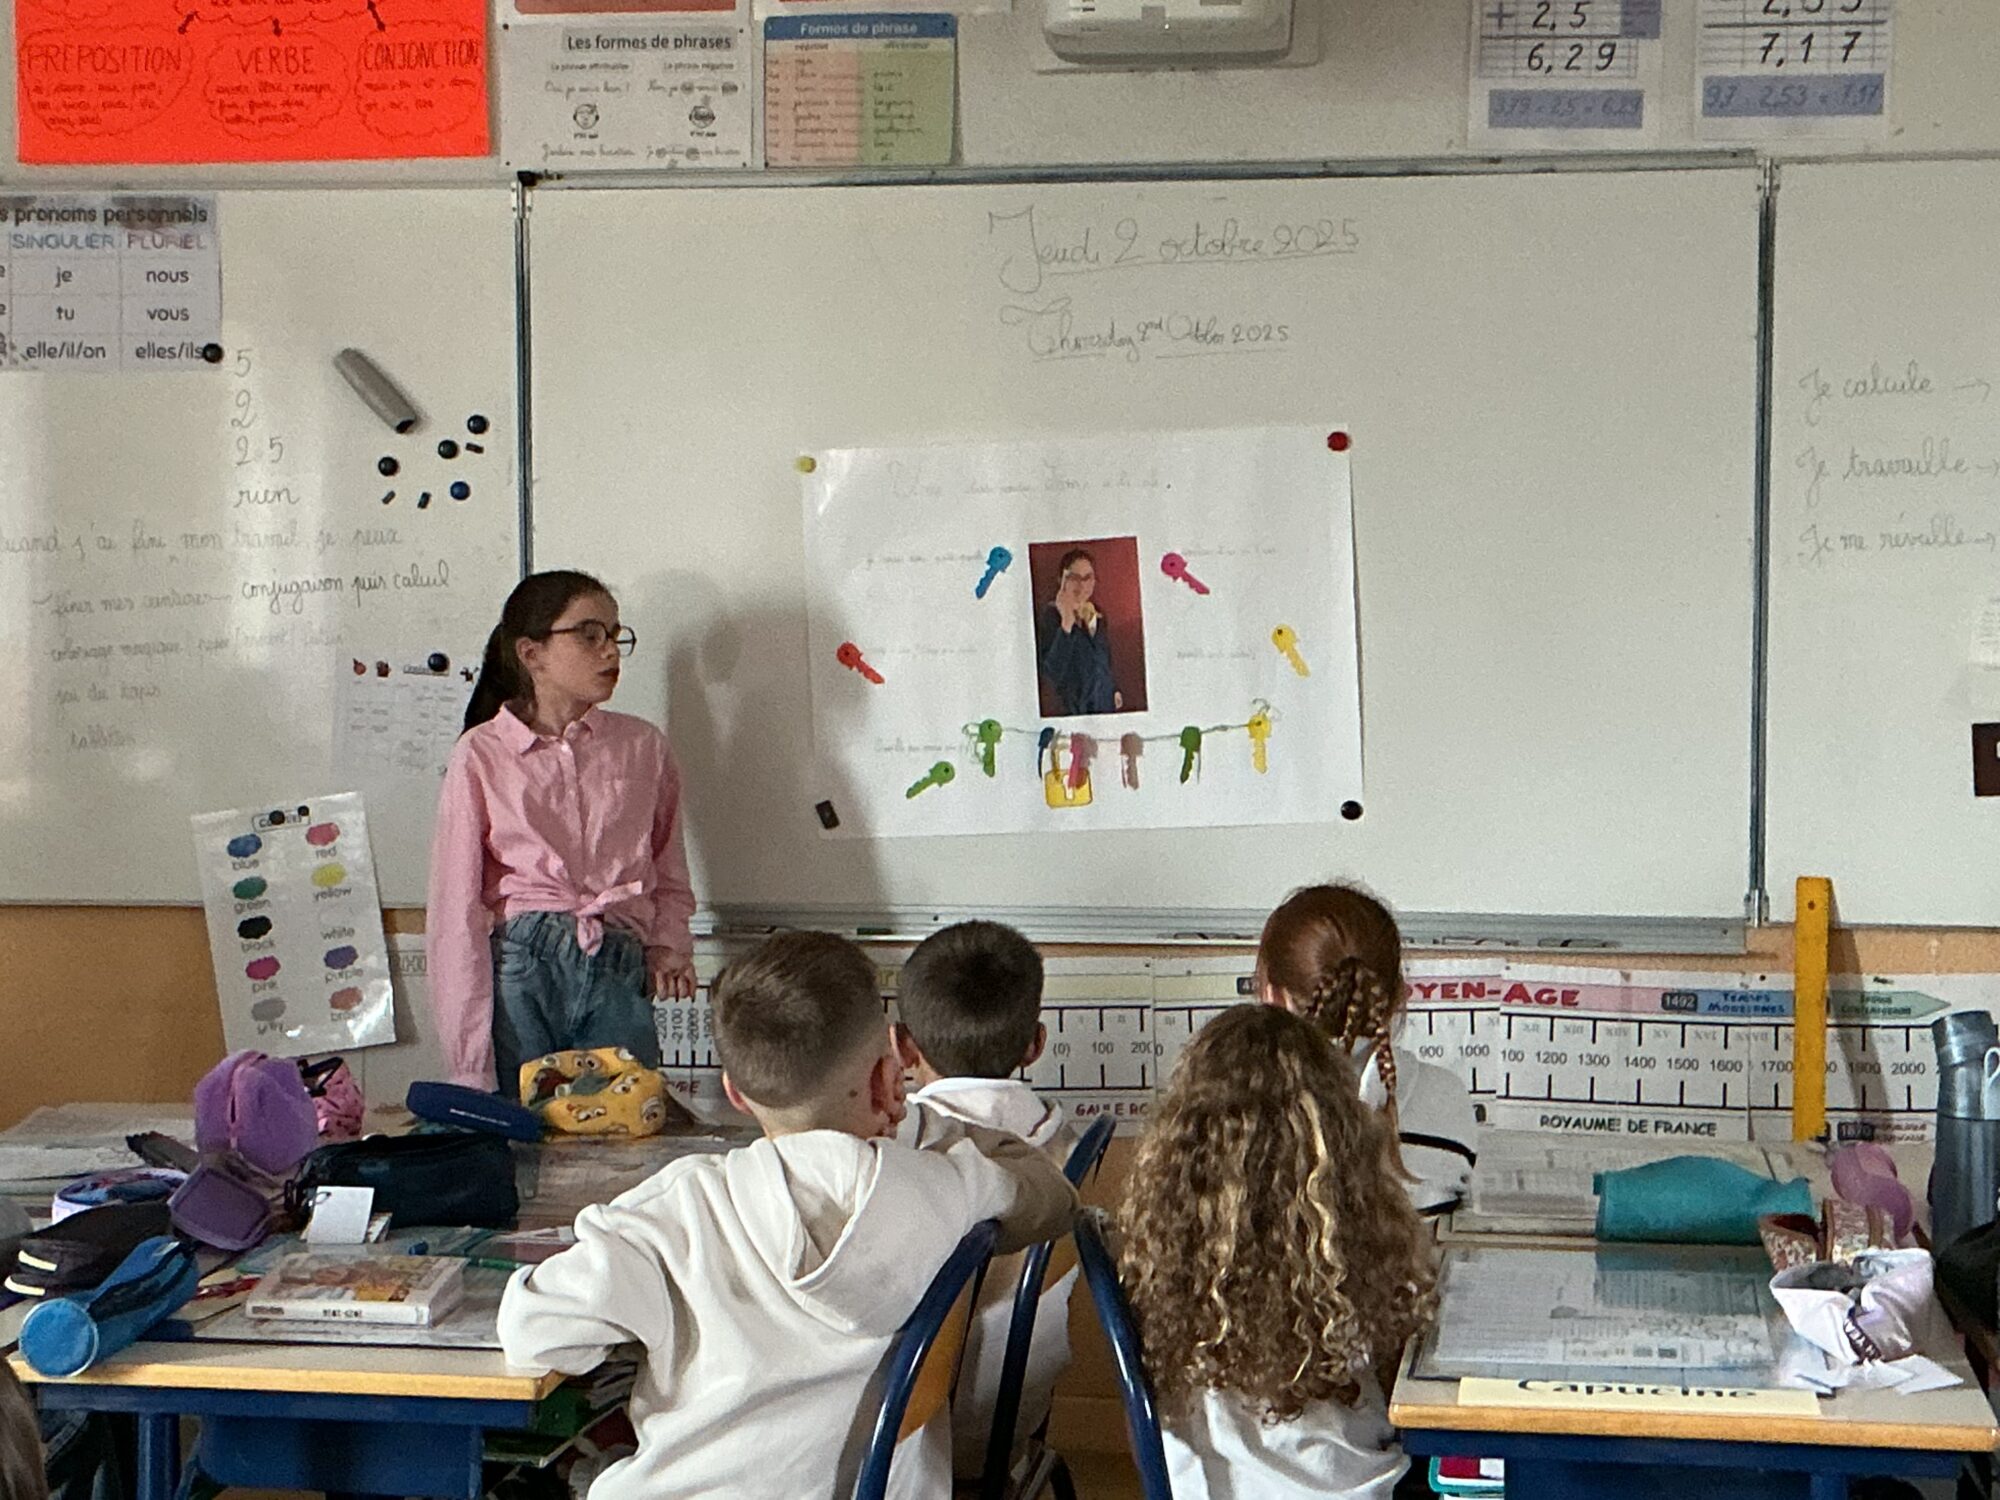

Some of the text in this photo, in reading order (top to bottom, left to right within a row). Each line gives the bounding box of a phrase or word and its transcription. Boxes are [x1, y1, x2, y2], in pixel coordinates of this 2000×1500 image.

[801, 22, 918, 36] Formes de phrase
[568, 33, 732, 50] Les formes de phrases
[236, 45, 315, 75] VERBE
[15, 205, 97, 226] pronoms
[103, 204, 208, 226] personnels
[12, 233, 114, 250] SINGULIER
[988, 204, 1100, 295] Jeudi
[1113, 217, 1147, 265] 2
[1273, 217, 1360, 256] 2025
[55, 266, 189, 288] je nous
[56, 305, 190, 322] tu vous
[1231, 323, 1289, 344] 2025
[26, 341, 204, 360] elle/il/on elles/ils
[1842, 435, 1969, 482] travaille
[233, 487, 301, 508] rien
[2, 525, 61, 553] uand
[241, 567, 344, 615] conjugaison
[231, 845, 338, 872] blue red
[313, 885, 352, 901] yellow
[233, 898, 271, 915] green
[320, 926, 356, 941] white
[241, 938, 275, 953] black
[1052, 1042, 1071, 1058] (0)
[1092, 1041, 1115, 1055] 100
[1419, 1044, 1444, 1058] 900
[1458, 1044, 1490, 1057] 1000
[1501, 1049, 1525, 1063] 100
[1535, 1051, 1568, 1065] 1200
[1578, 1053, 1610, 1068] 1300
[1625, 1056, 1657, 1070] 1400
[1667, 1058, 1700, 1071] 1500
[1710, 1059, 1743, 1073] 1600
[1761, 1060, 1794, 1073] 1700
[1891, 1062, 1927, 1076] 2000
[1540, 1114, 1717, 1137] ROYAUME DE FRANCE
